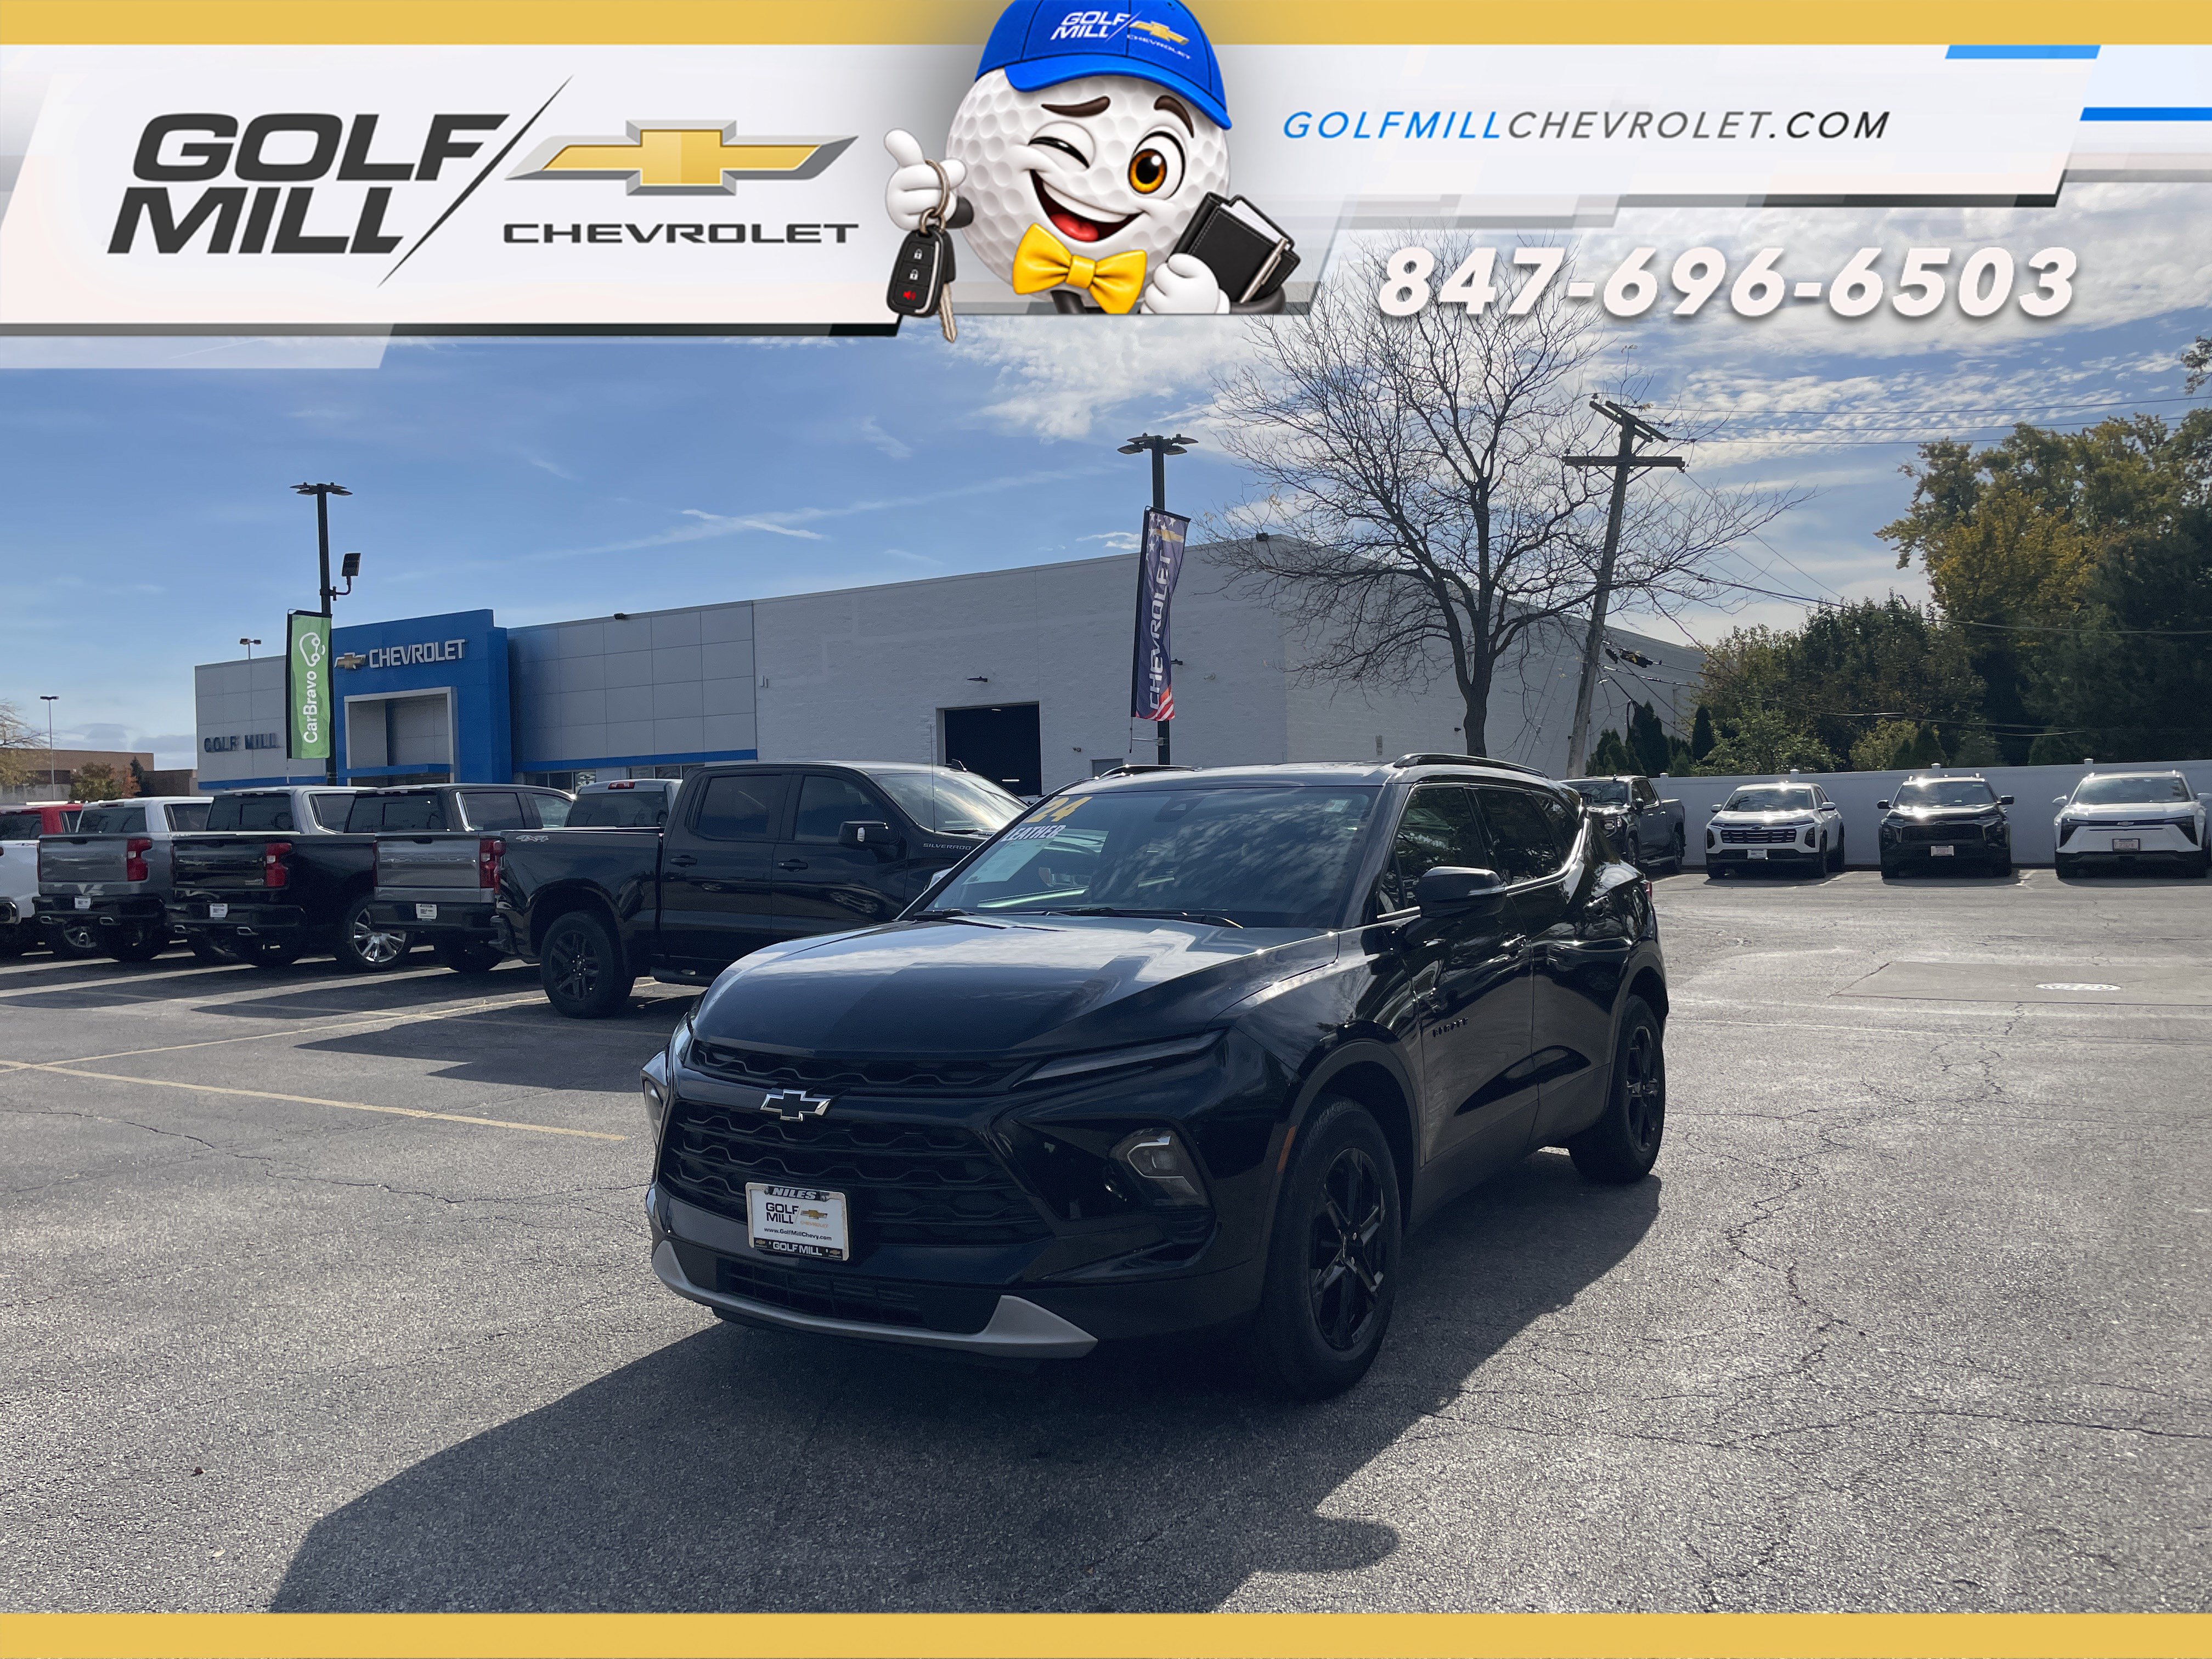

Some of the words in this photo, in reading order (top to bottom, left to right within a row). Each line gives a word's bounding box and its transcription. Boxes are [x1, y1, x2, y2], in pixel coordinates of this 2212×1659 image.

[1149, 550, 1171, 710] CHEVROLET
[369, 639, 465, 668] CHEVROLET
[303, 670, 318, 743] CarBravo
[1025, 797, 1093, 822] 24
[1000, 825, 1066, 842] LEATHER
[772, 1187, 817, 1200] NILES
[766, 1202, 799, 1215] GOLF
[766, 1212, 794, 1224] MILL
[764, 1227, 832, 1241] www.GolfMillChevy.com
[772, 1242, 798, 1252] GOLF
[799, 1245, 822, 1256] MILL
